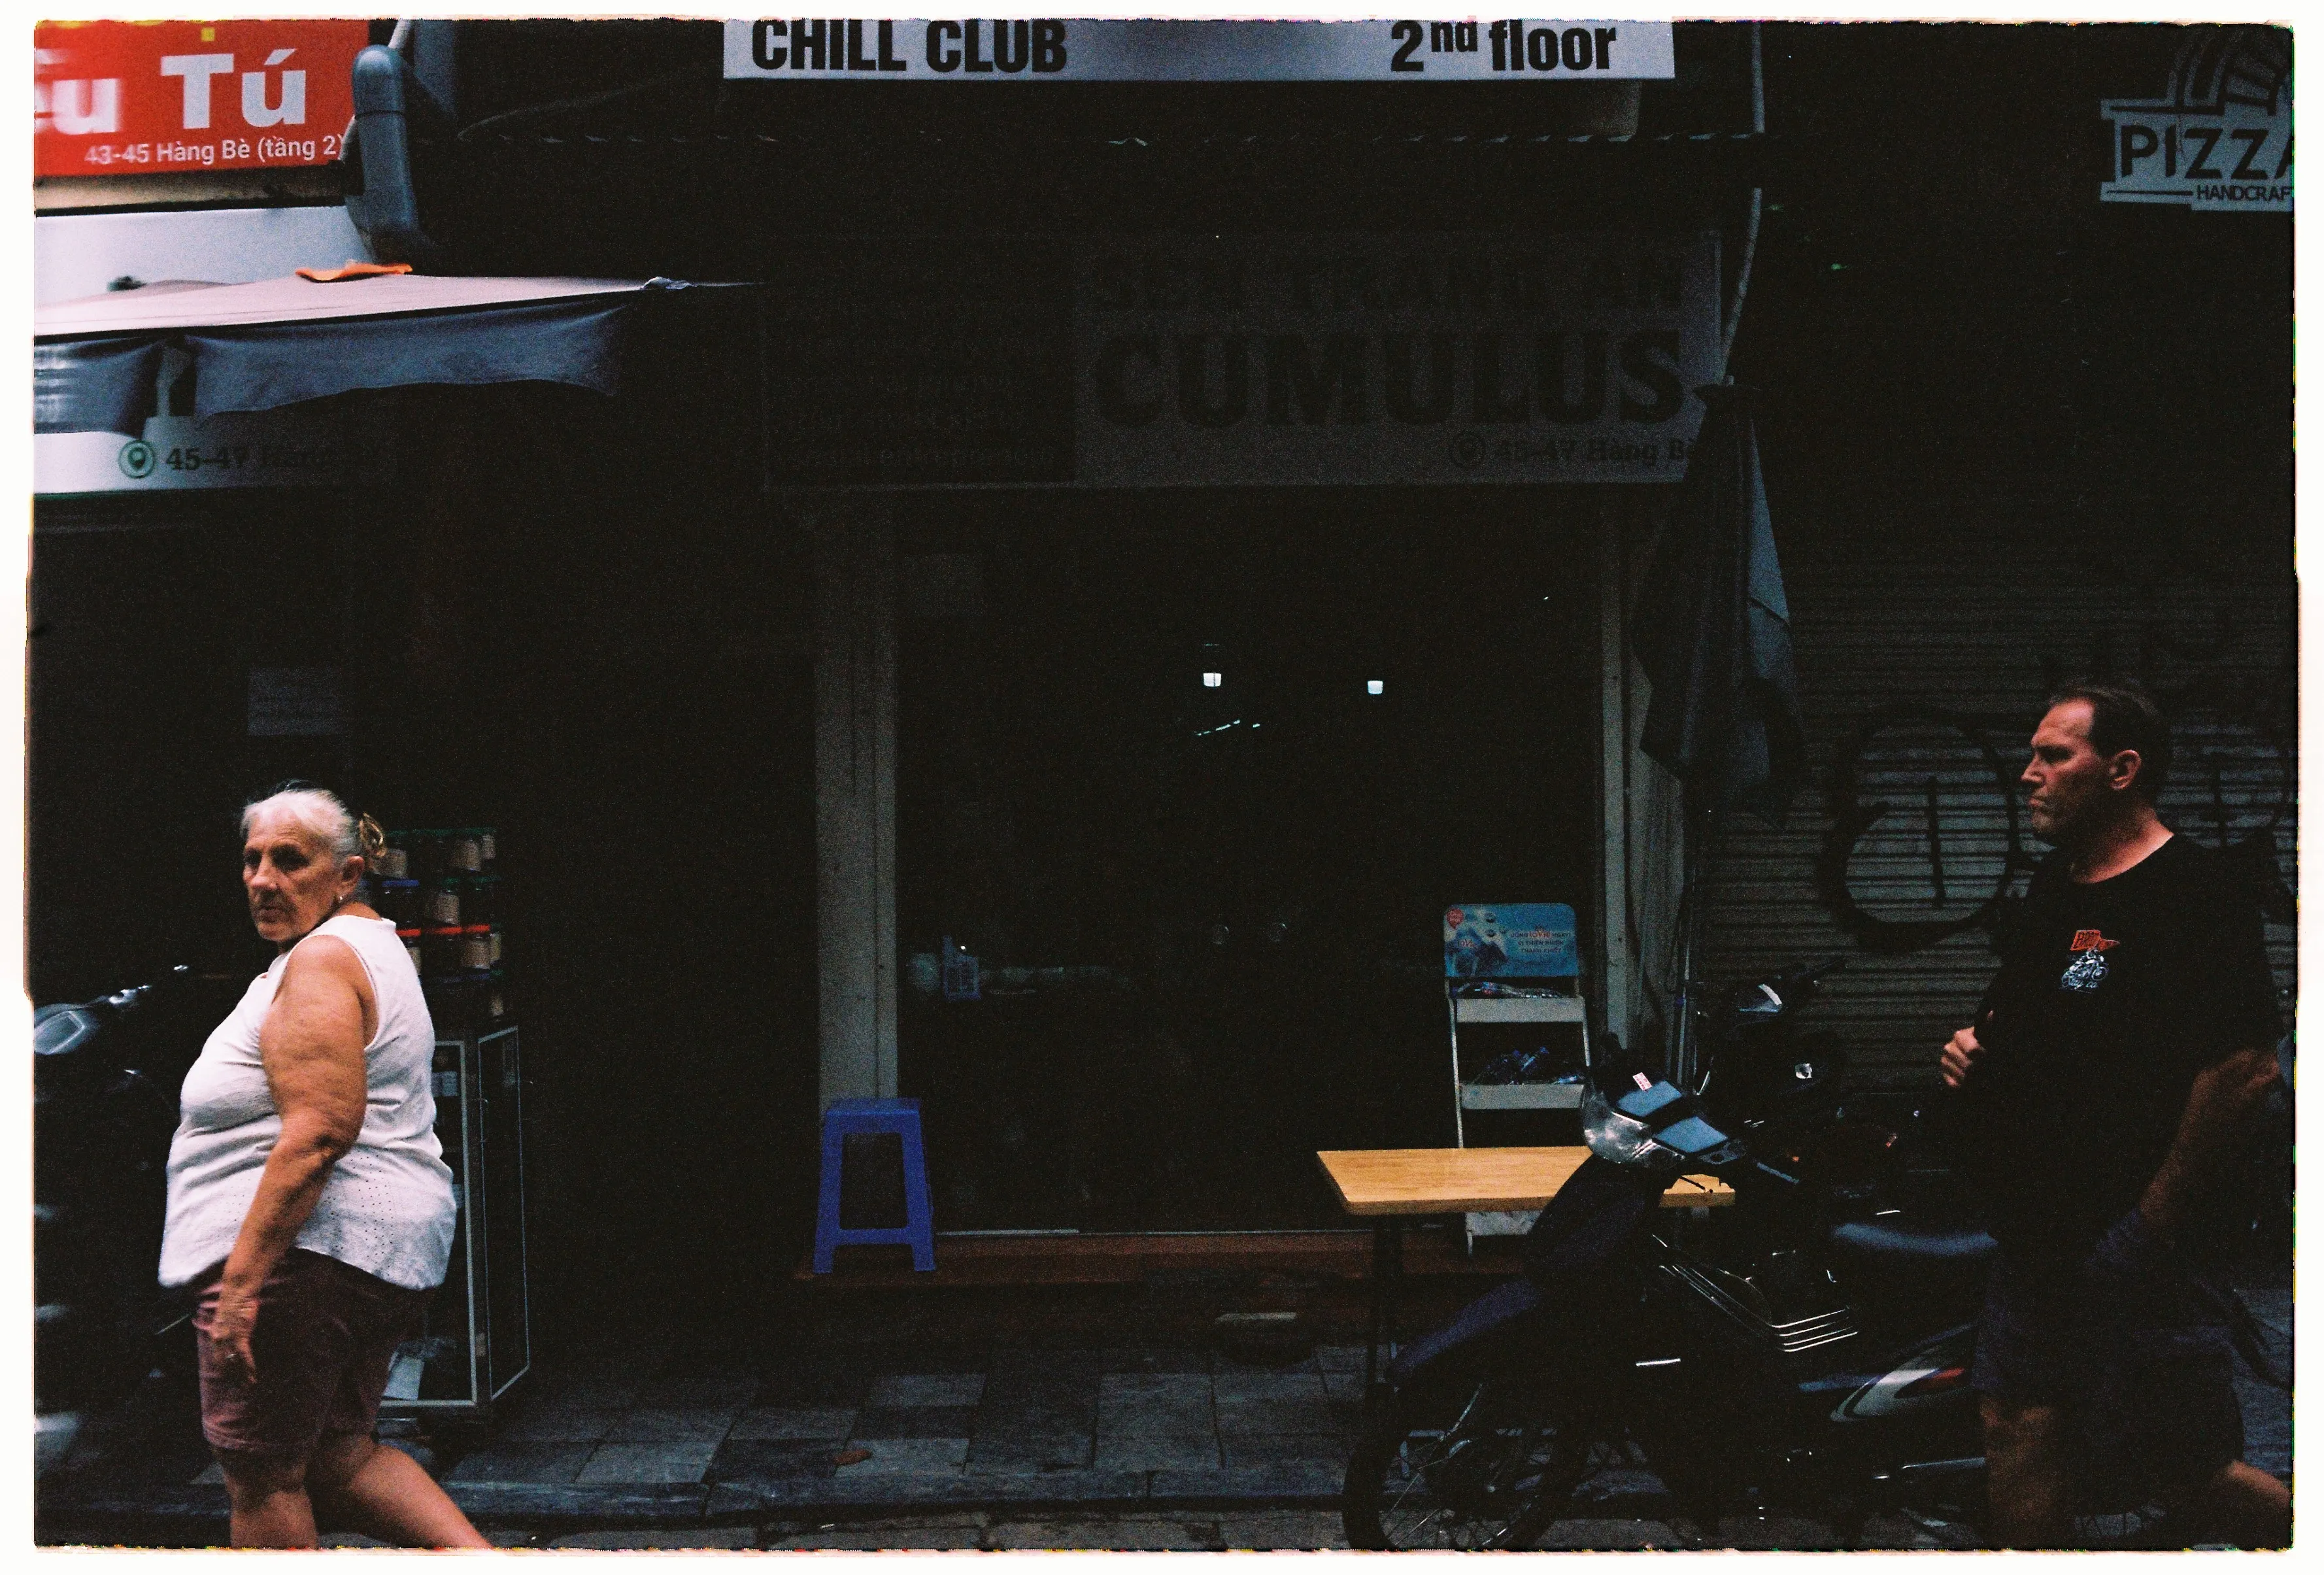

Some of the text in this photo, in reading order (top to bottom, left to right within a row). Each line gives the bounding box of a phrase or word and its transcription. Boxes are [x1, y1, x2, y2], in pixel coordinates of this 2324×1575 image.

[752, 20, 907, 71] CHILL
[926, 20, 1067, 73] CLUB
[1489, 20, 1617, 71] floor
[161, 48, 306, 130] Tú
[84, 143, 150, 165] 43-45
[156, 141, 215, 165] Hàng
[222, 137, 250, 160] Bè
[258, 134, 316, 163] (tầng
[1094, 328, 1684, 428] CUMULUS
